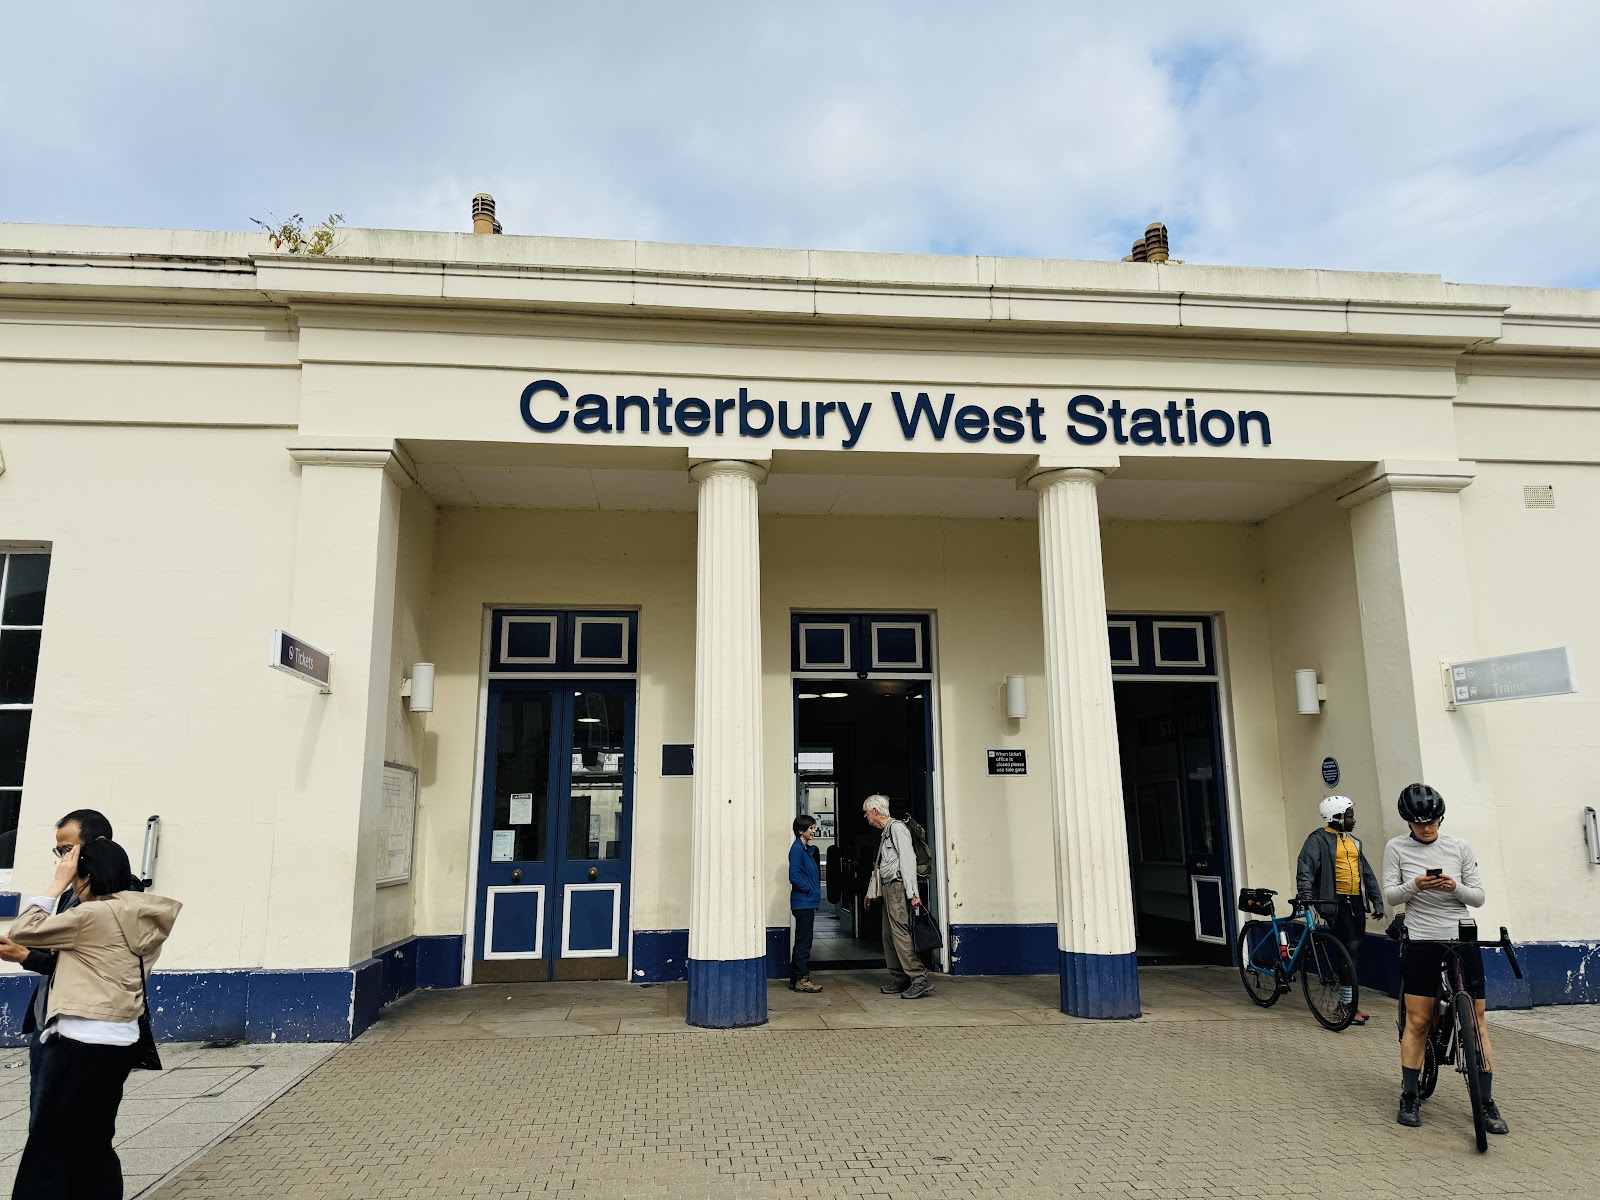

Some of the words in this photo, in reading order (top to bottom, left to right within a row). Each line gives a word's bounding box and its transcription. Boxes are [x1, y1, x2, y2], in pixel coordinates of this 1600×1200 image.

[519, 379, 872, 450] Canterbury
[891, 391, 1046, 444] West
[1067, 394, 1272, 446] Station
[294, 647, 314, 670] Tickets
[1488, 661, 1528, 674] Tickets
[1492, 681, 1526, 695] Trains
